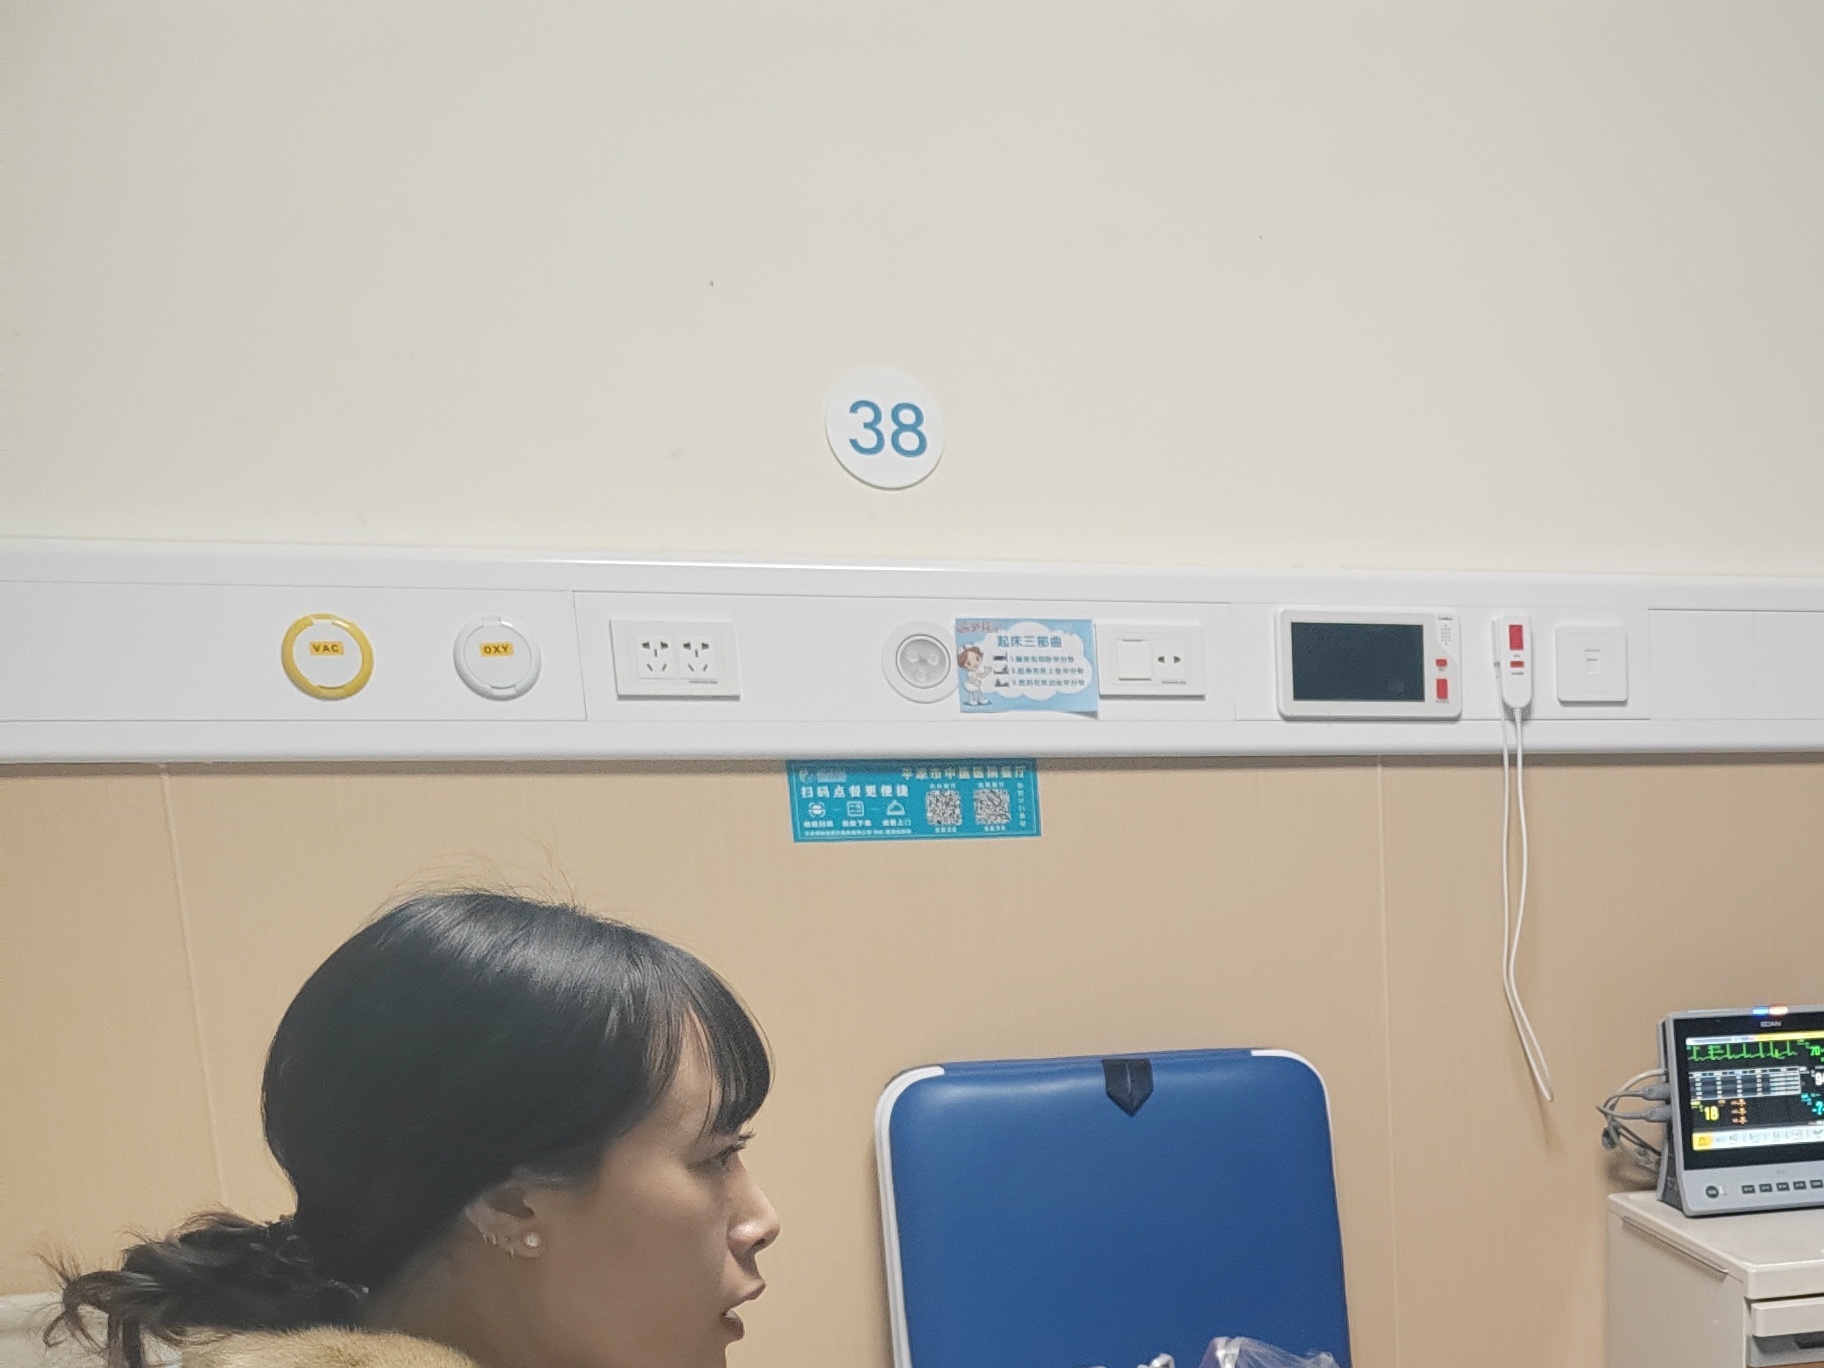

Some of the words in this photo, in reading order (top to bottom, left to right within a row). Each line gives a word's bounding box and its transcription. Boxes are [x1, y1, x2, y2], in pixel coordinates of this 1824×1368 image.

[848, 399, 928, 458] 38
[997, 635, 1062, 648] 起床三部曲
[312, 643, 341, 654] VAC
[483, 644, 510, 655] OXY
[801, 784, 909, 798] 扫码点餐更便捷
